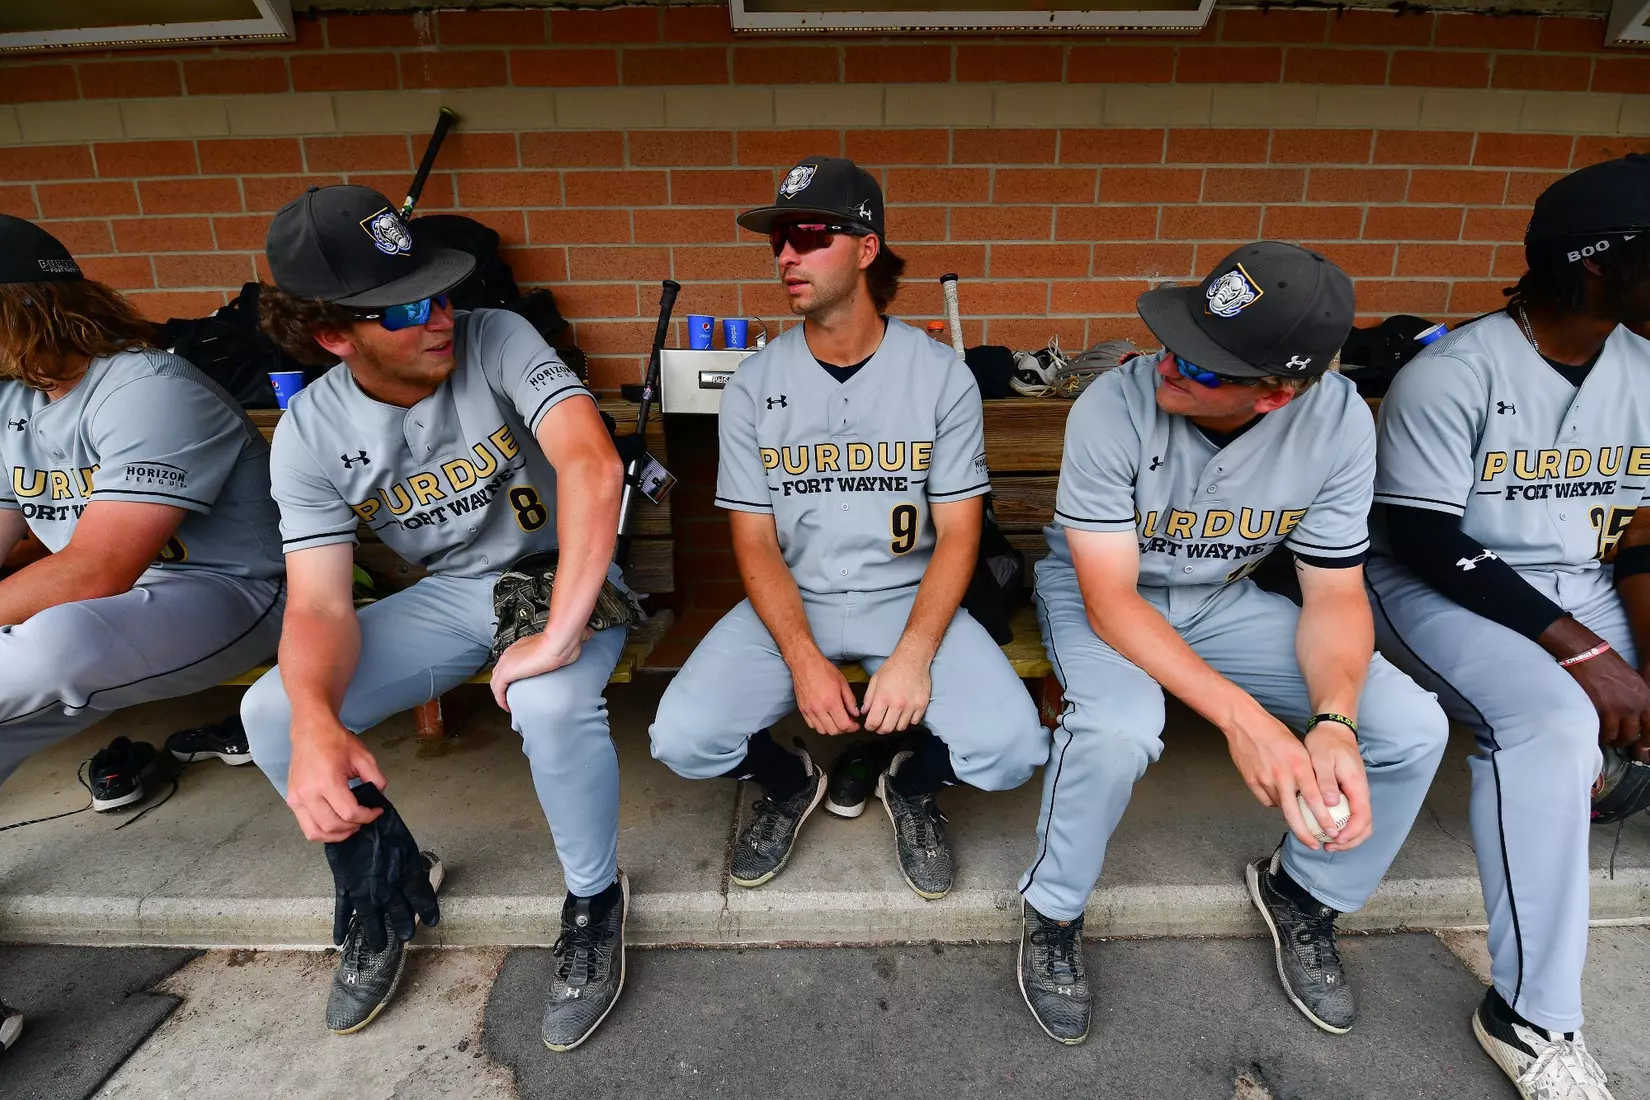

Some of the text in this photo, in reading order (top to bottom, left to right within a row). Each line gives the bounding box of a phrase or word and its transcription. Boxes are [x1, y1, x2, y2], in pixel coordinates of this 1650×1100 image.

[759, 440, 934, 476] PURDUE
[1480, 445, 1650, 482] PURDUE
[125, 475, 184, 488] LEAGUE
[126, 466, 185, 482] HORIZON
[353, 423, 521, 523] PURDUE
[782, 476, 909, 497] FORT WAYNE
[398, 467, 515, 531] ORT WAYNE
[1505, 480, 1618, 501] FOT WAYNE
[21, 502, 70, 521] ORT
[506, 483, 549, 533] 8
[890, 501, 920, 556] 9
[1186, 541, 1268, 560] WAYNE
